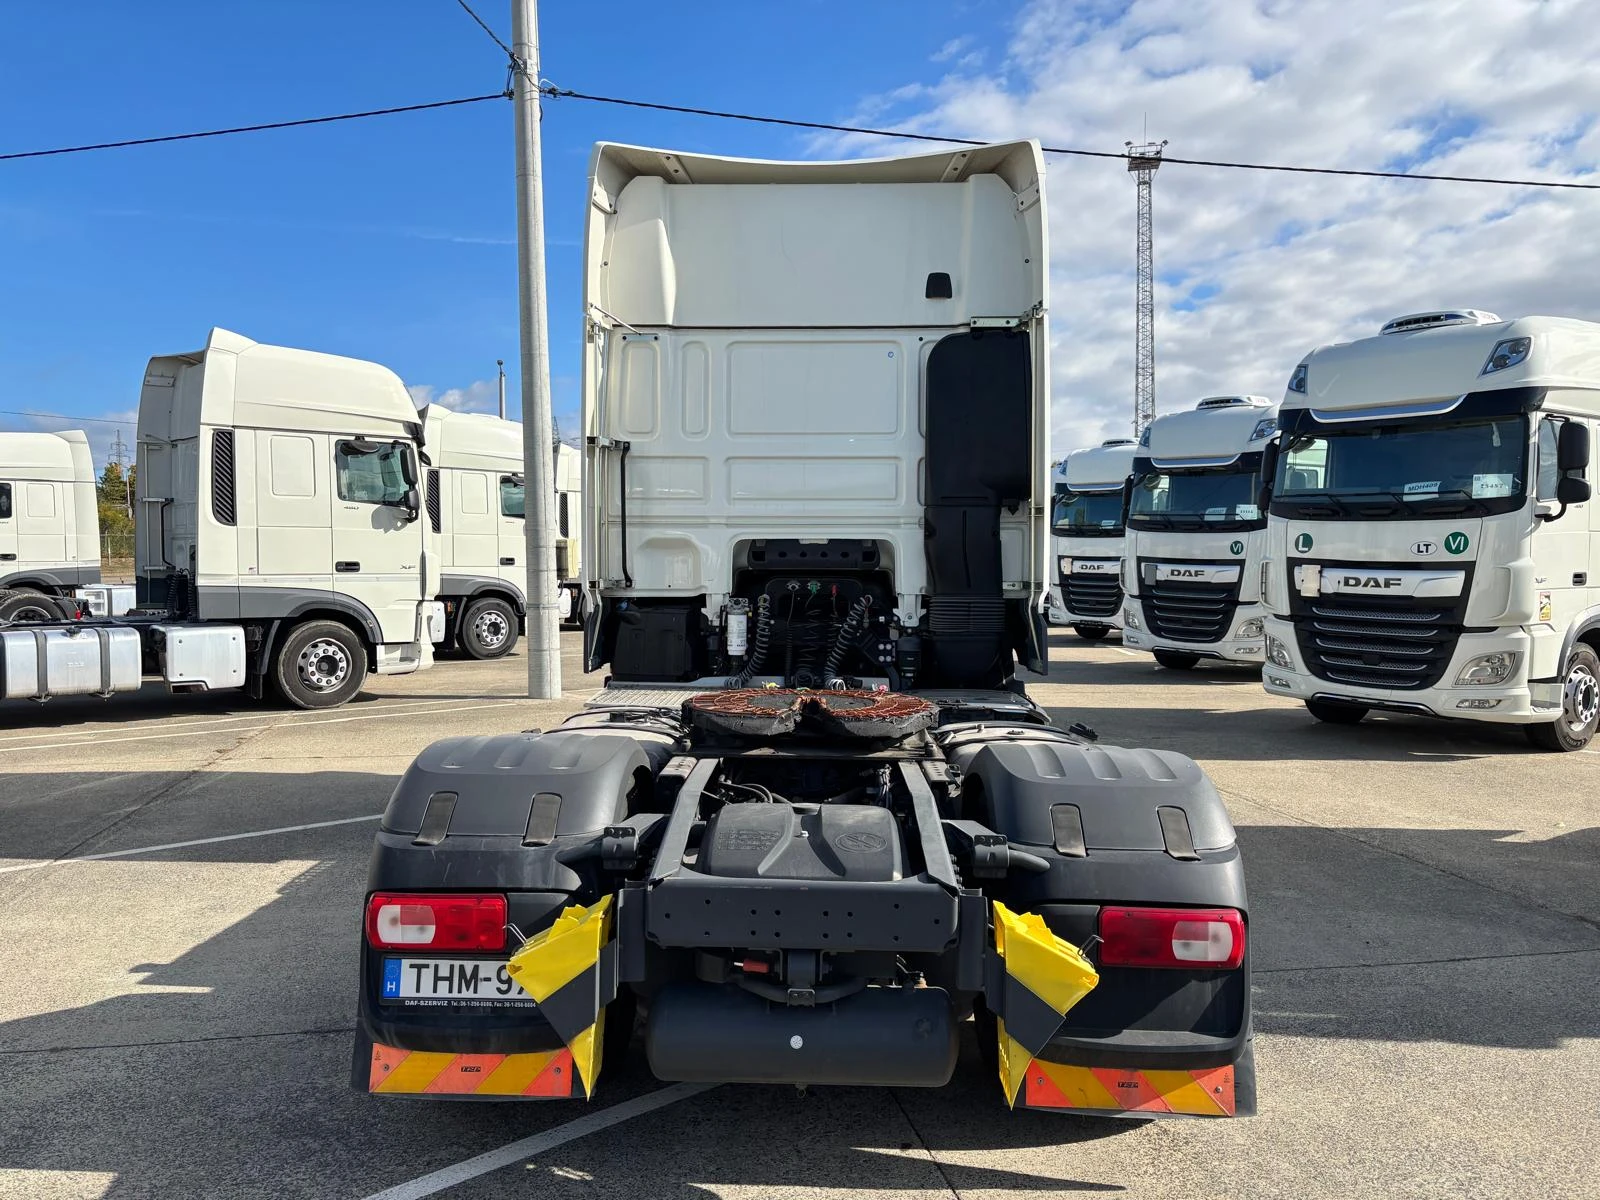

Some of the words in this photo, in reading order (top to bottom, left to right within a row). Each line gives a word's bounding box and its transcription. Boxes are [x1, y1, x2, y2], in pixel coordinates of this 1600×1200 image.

[1232, 543, 1243, 552] VI
[1298, 535, 1309, 551] L
[1417, 543, 1432, 554] LT
[1449, 536, 1464, 551] VI
[1170, 569, 1205, 577] DAF
[1343, 576, 1402, 588] DAF
[409, 963, 528, 995] THM-9
[386, 981, 396, 992] H
